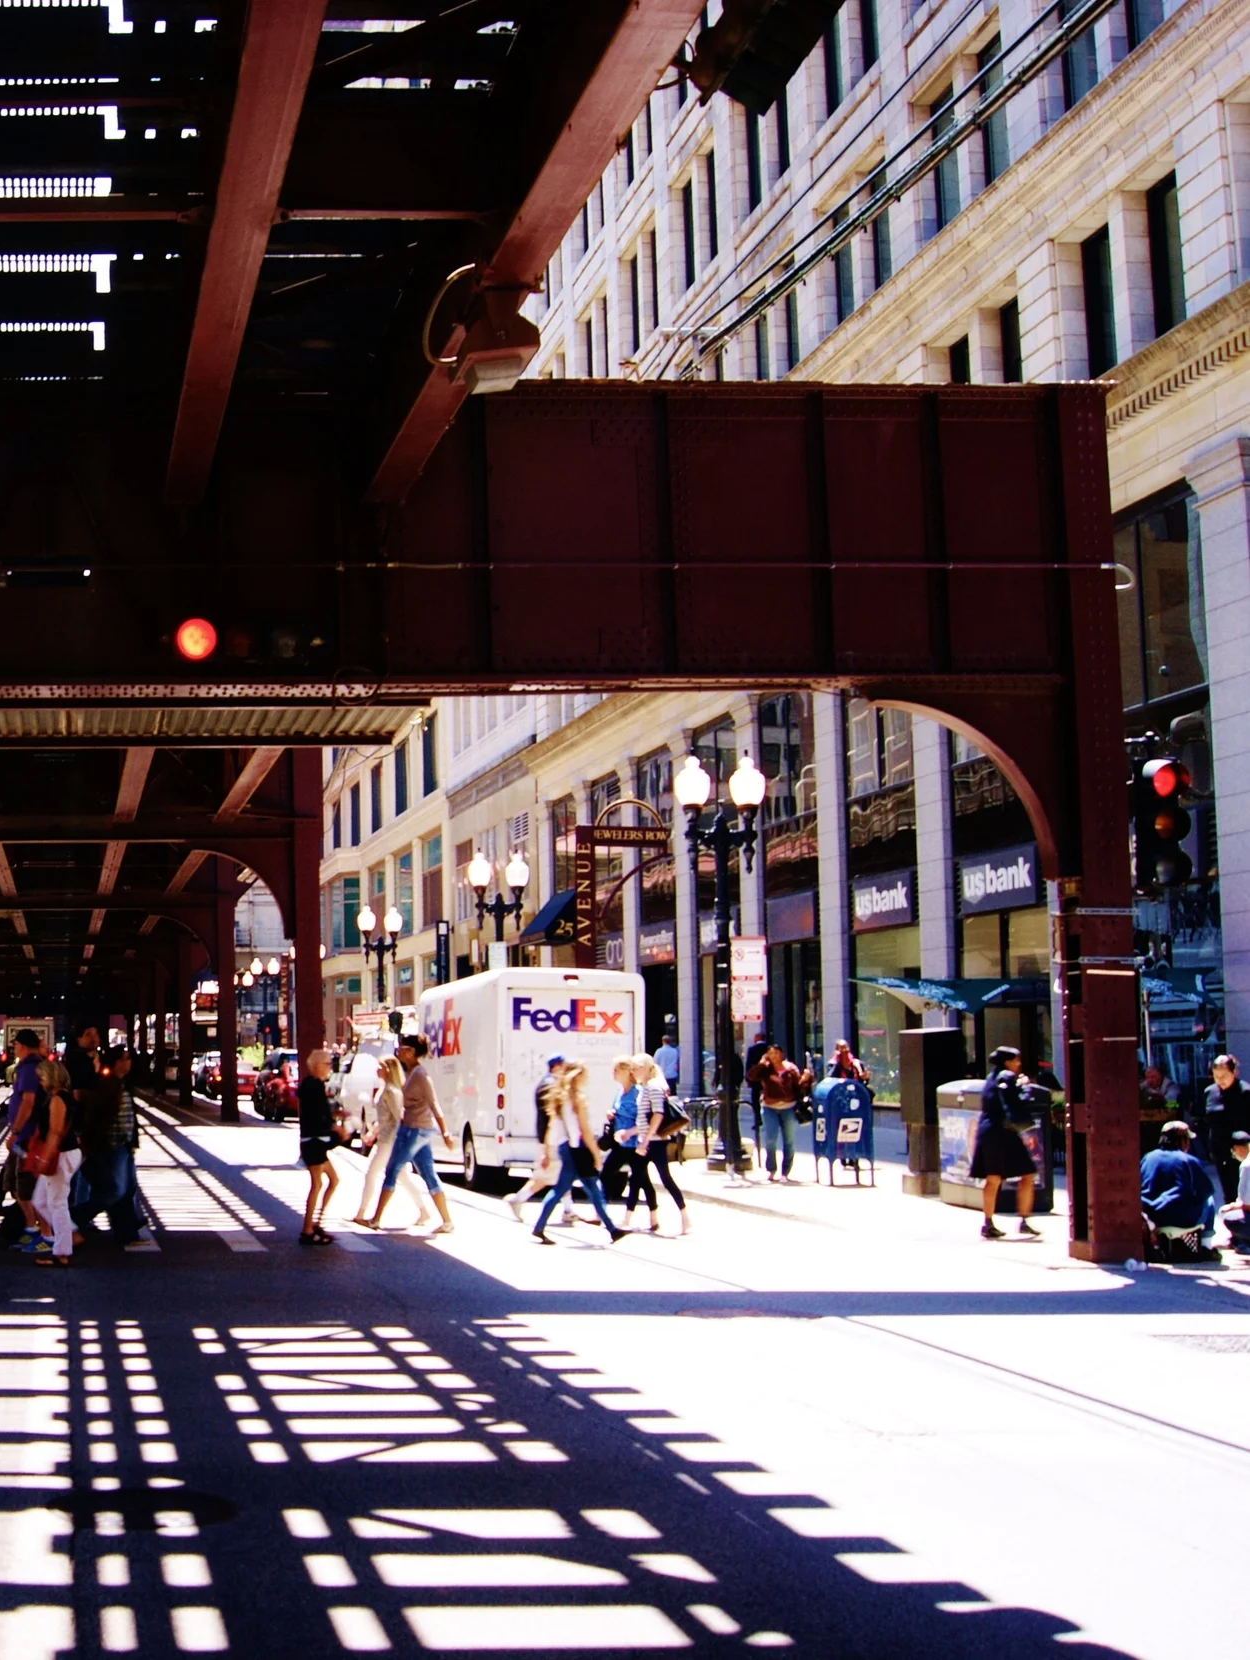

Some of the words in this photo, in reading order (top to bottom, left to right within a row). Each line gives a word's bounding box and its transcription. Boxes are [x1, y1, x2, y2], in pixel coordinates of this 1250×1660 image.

[594, 829, 643, 840] JEWELERS
[645, 831, 667, 840] ROW
[577, 843, 592, 946] AVENUE
[555, 919, 574, 937] 25
[424, 998, 463, 1058] FedEx
[513, 997, 623, 1034] FedEx
